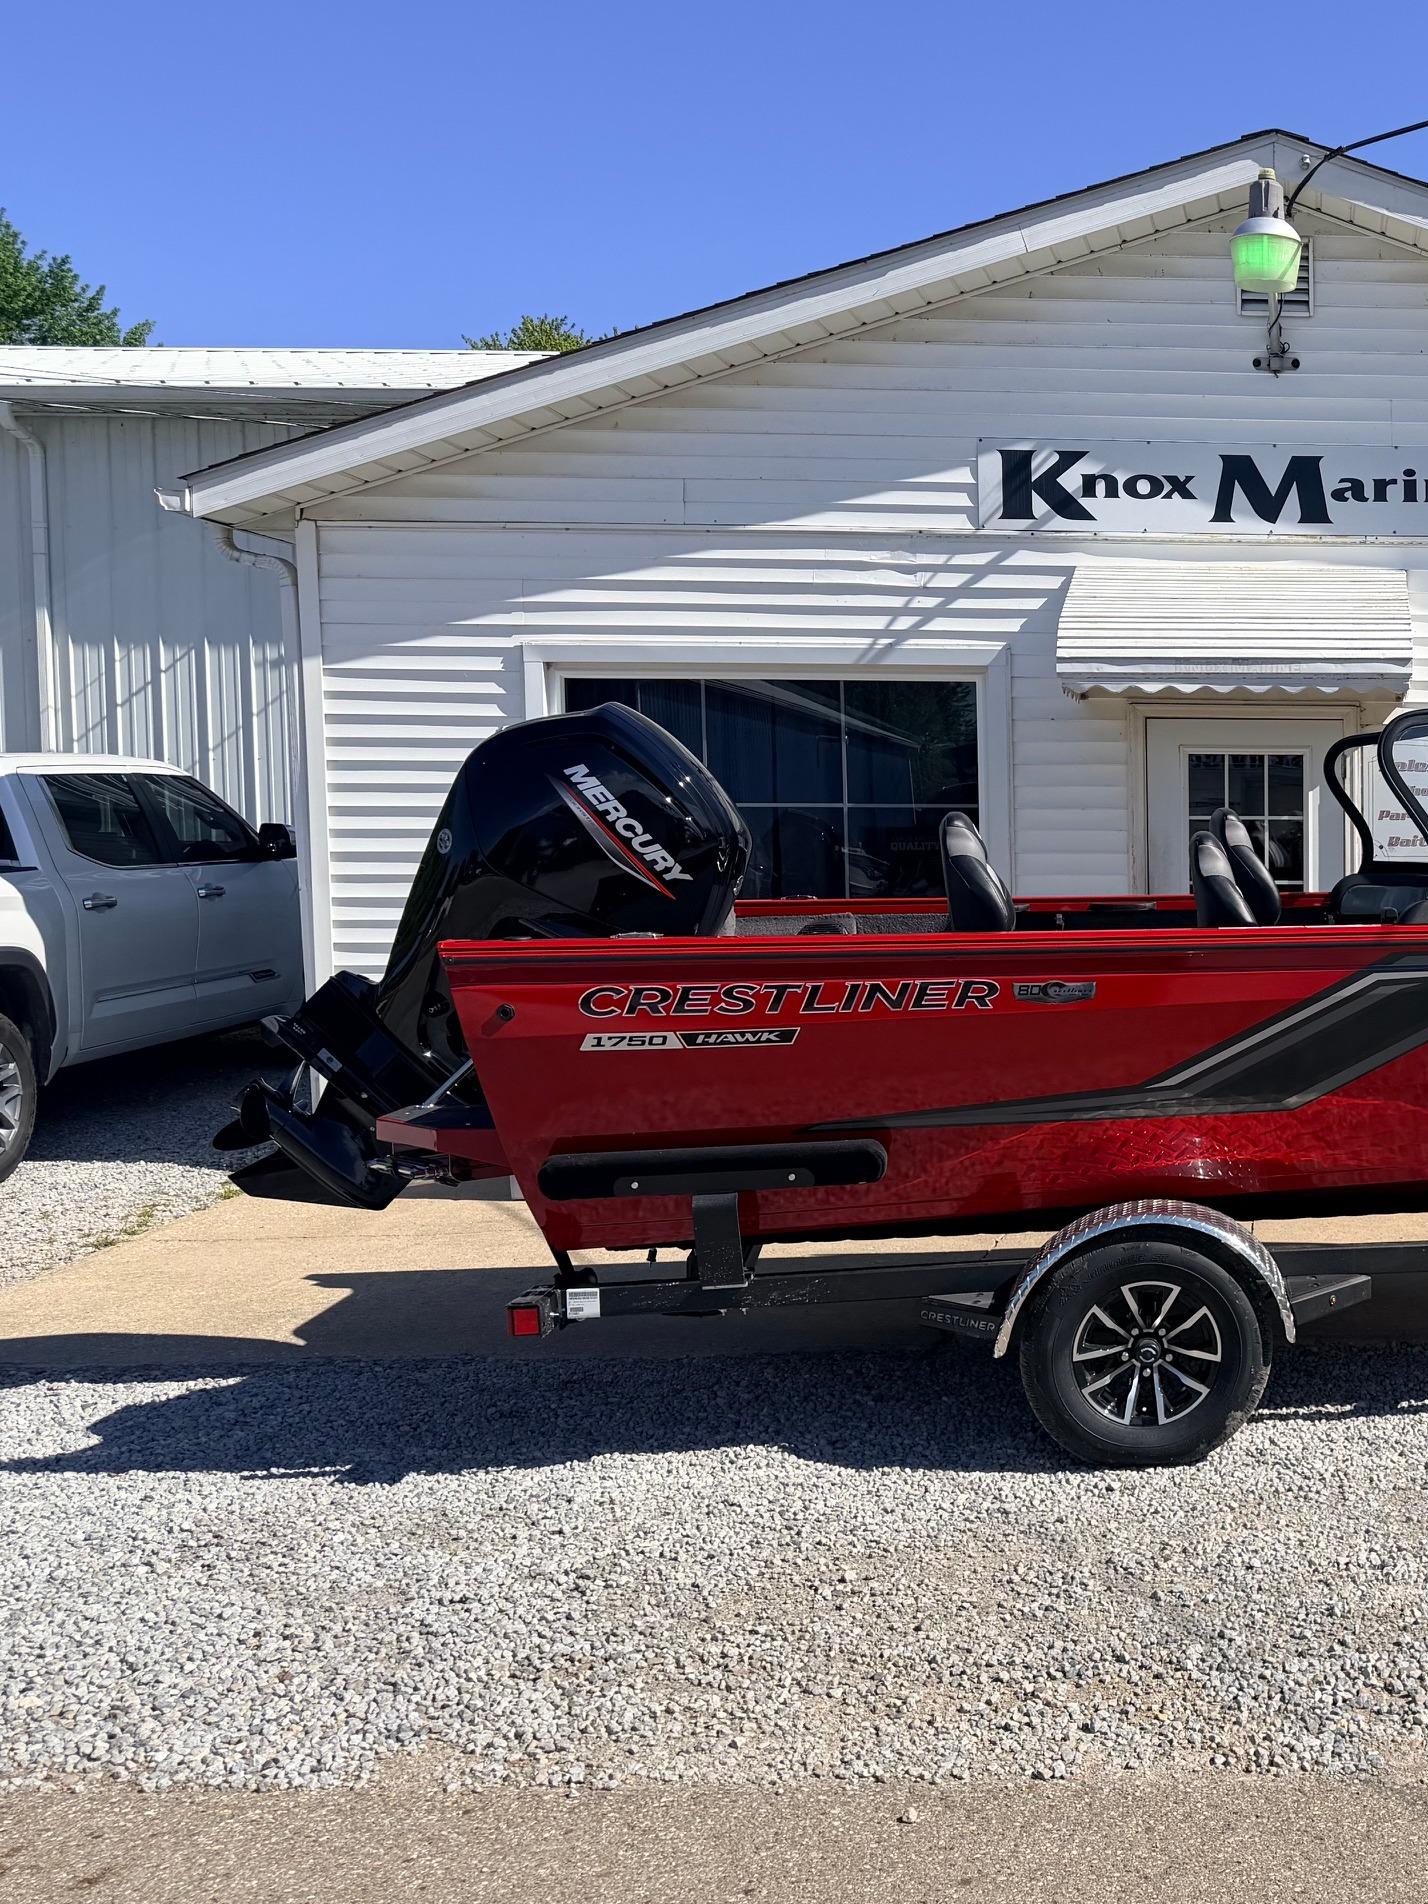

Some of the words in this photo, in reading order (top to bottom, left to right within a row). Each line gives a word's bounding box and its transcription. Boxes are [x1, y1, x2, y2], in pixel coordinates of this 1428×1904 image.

[996, 448, 1199, 522] Knox
[563, 764, 694, 881] MERCURY
[579, 978, 1001, 1018] CRESTLINER
[591, 1034, 668, 1048] 1750
[695, 1031, 783, 1045] HAWK
[920, 1309, 996, 1333] CRESTLINER
